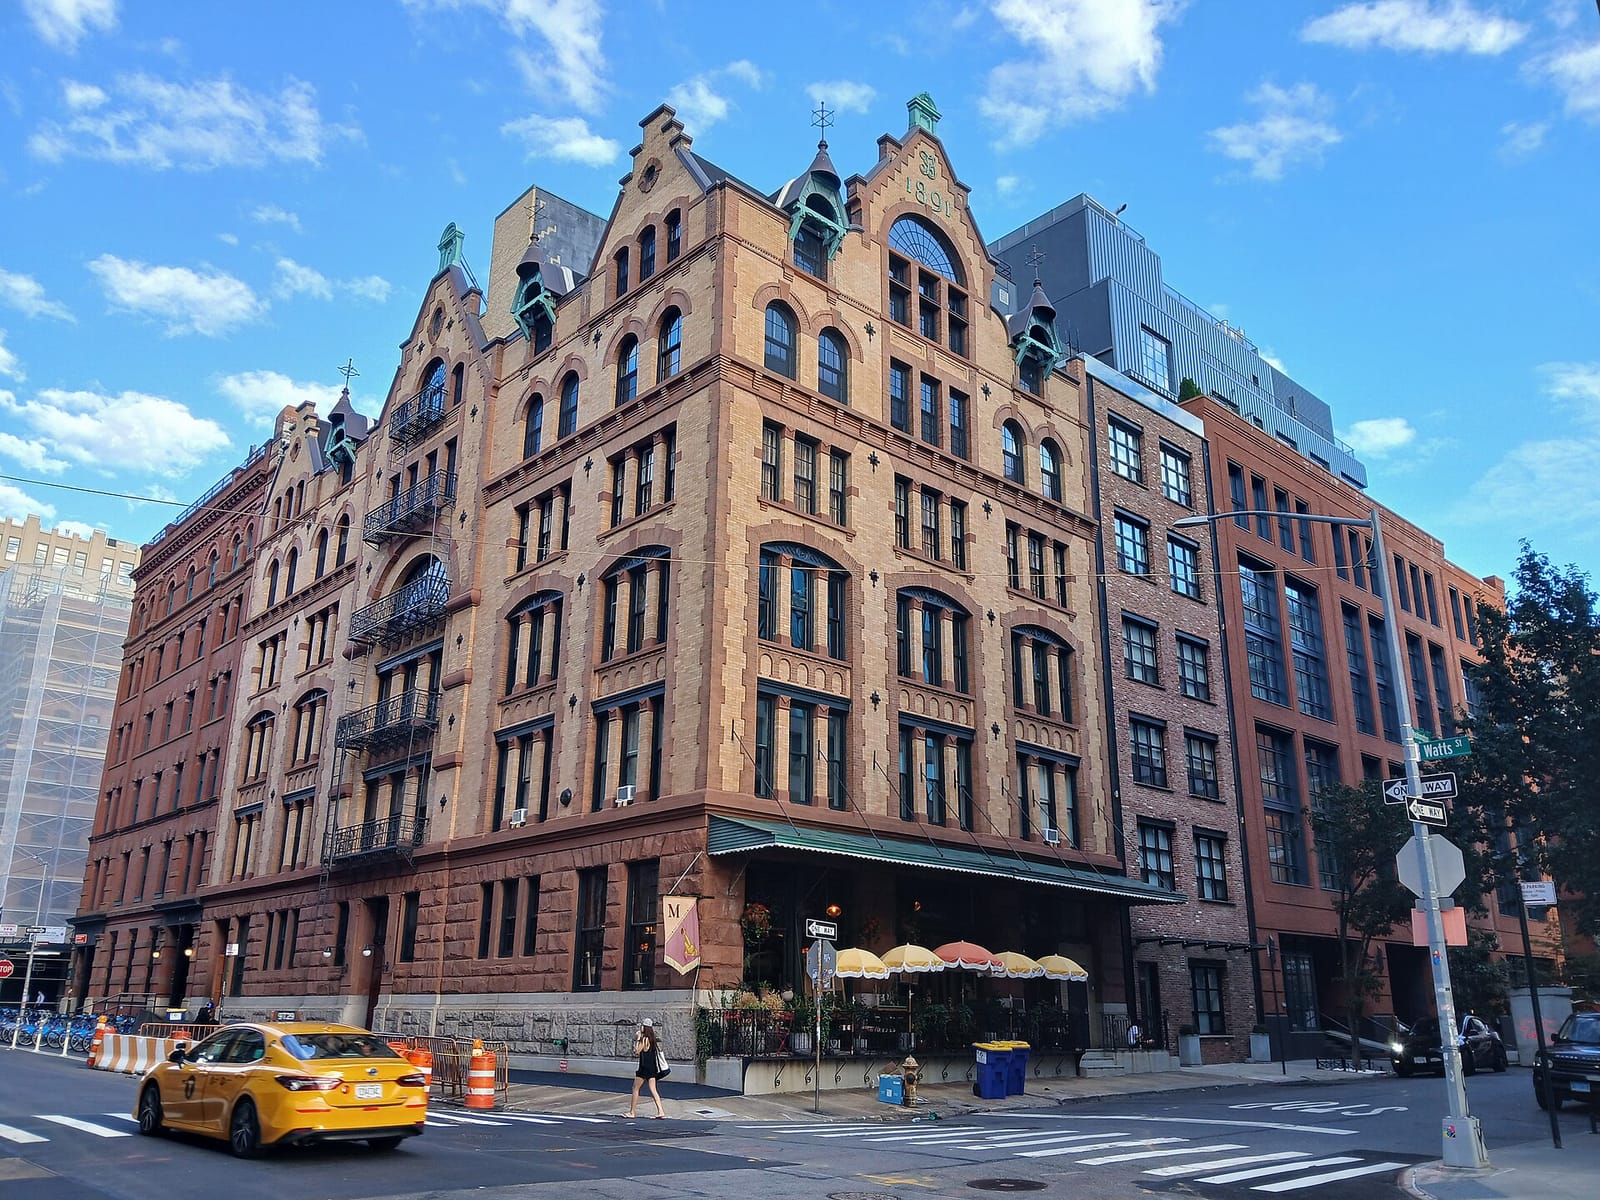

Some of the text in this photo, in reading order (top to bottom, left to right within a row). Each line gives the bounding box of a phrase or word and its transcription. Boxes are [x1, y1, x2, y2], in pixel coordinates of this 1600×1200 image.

[906, 176, 951, 218] 1891
[1423, 742, 1453, 758] Watts
[1425, 780, 1449, 792] WAY
[1413, 804, 1441, 817] ONE WAY
[667, 903, 681, 919] M
[0, 965, 12, 973] TOP
